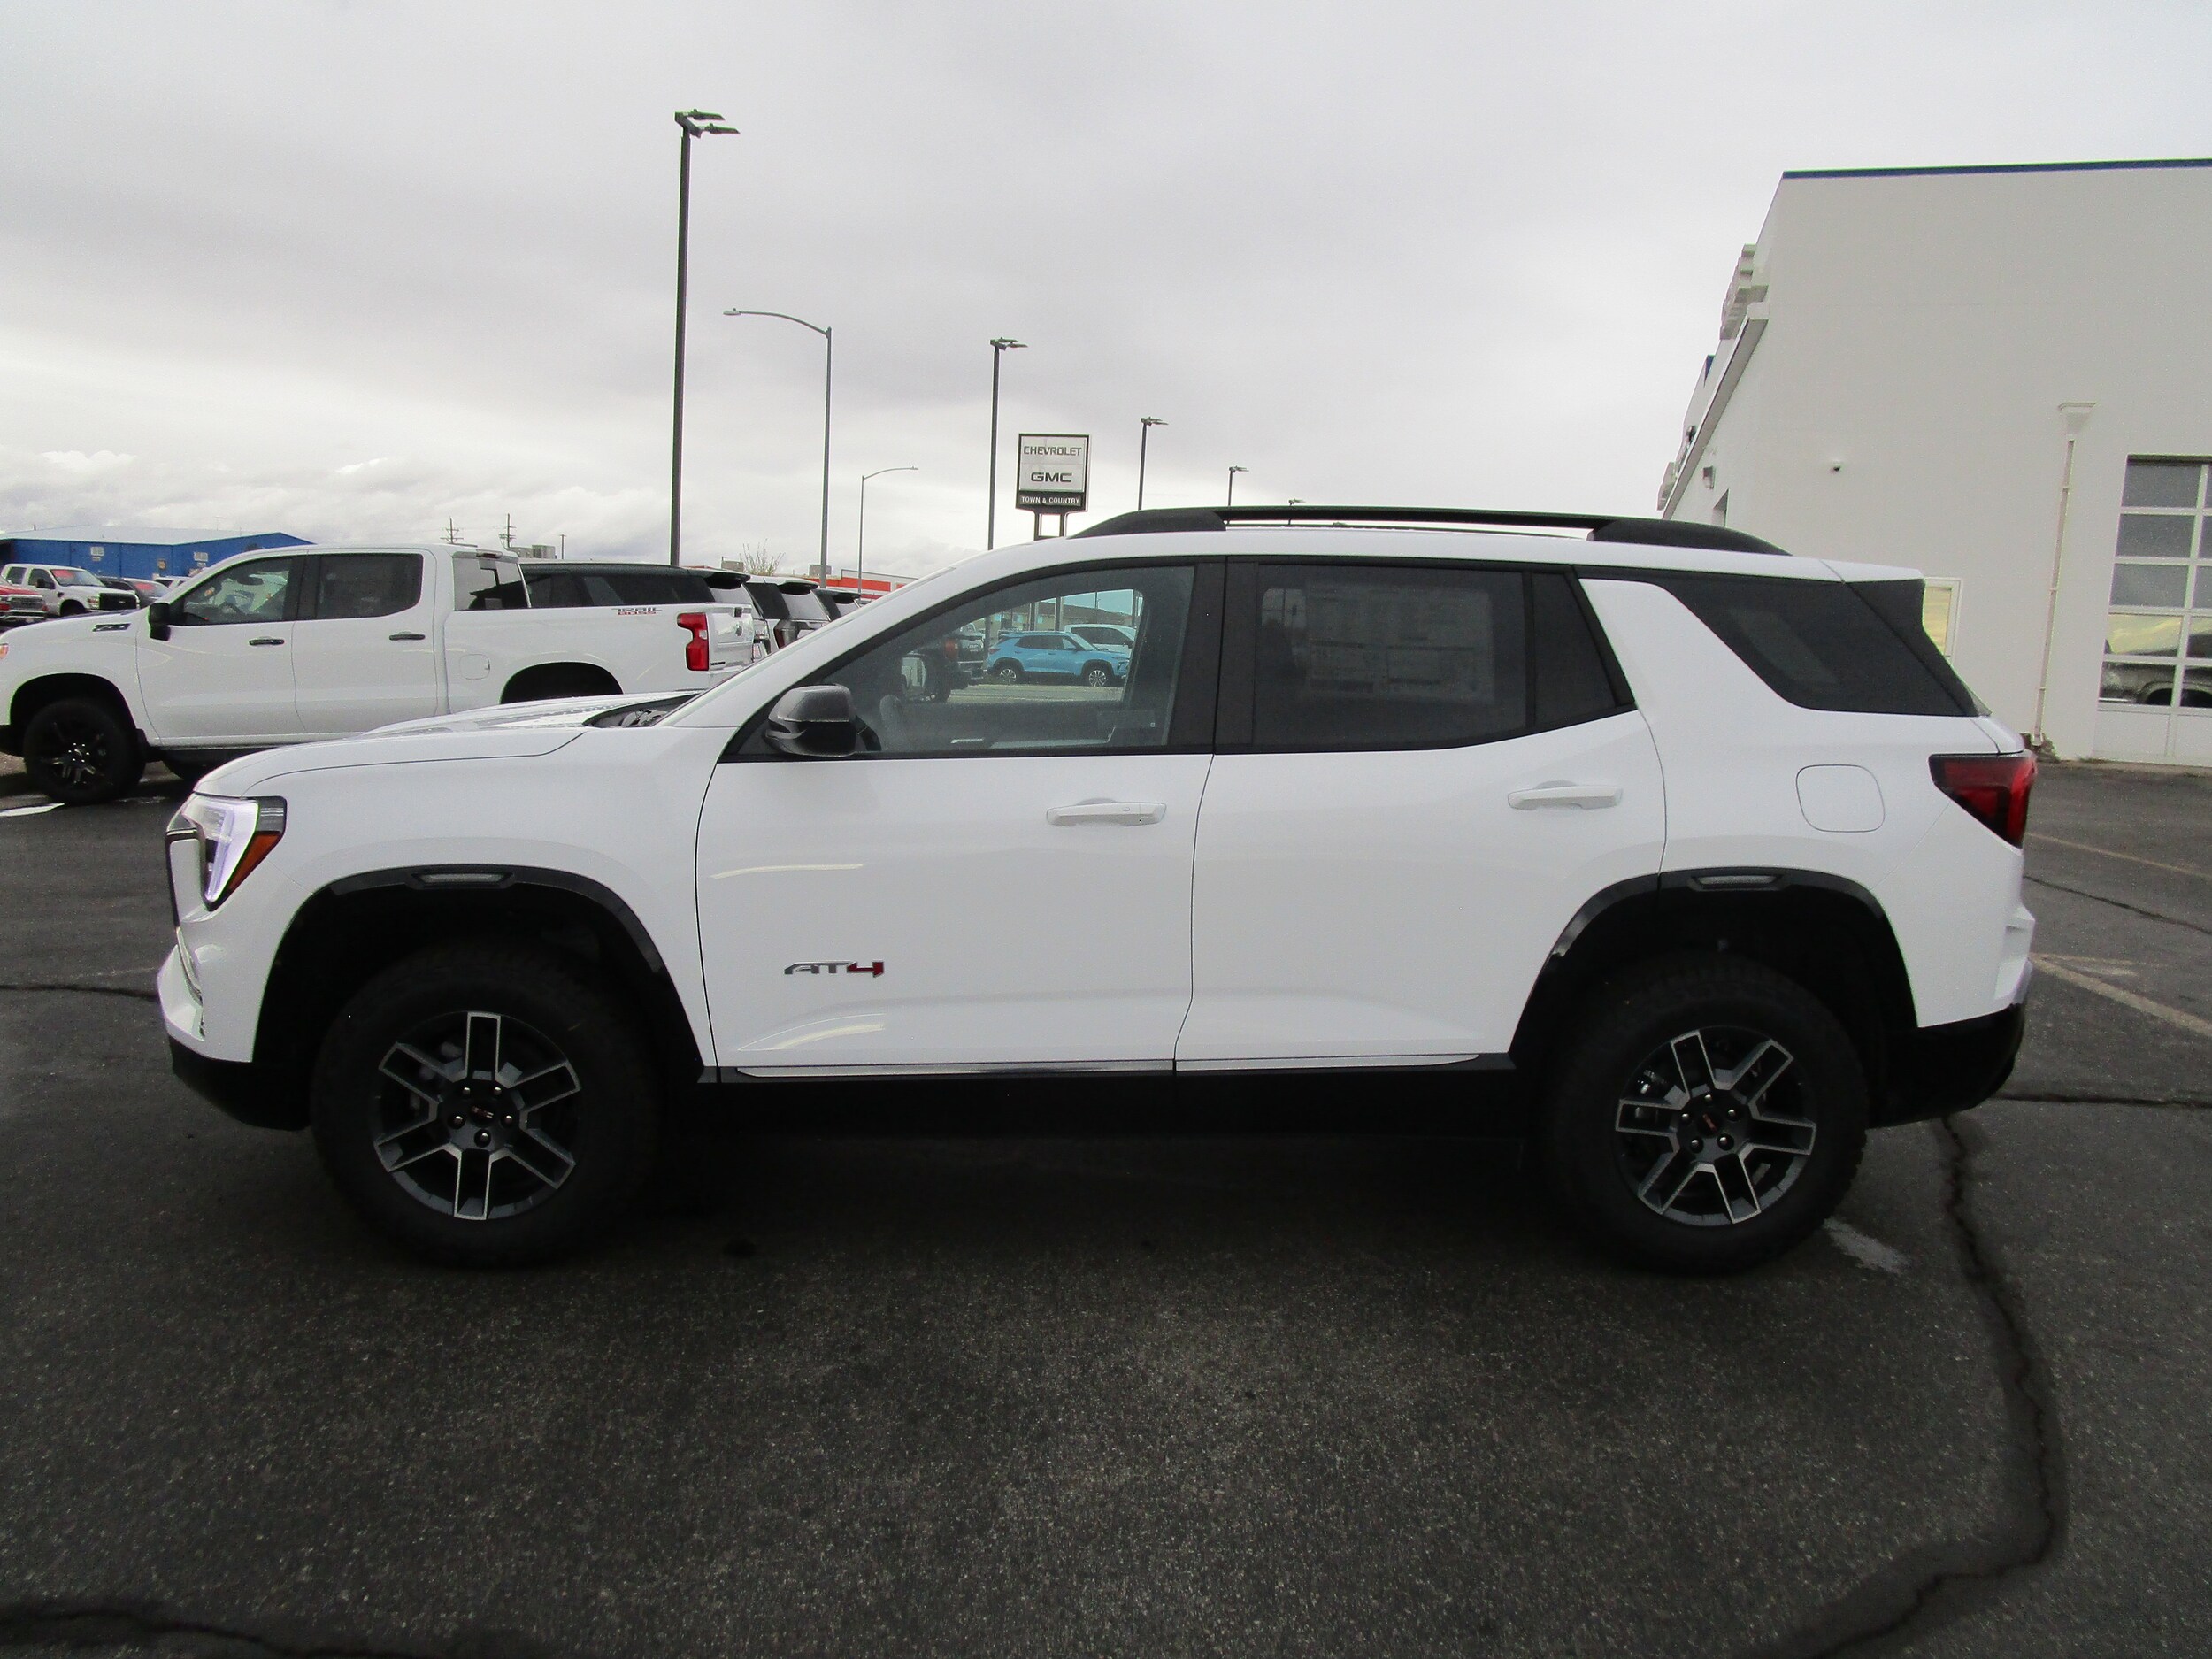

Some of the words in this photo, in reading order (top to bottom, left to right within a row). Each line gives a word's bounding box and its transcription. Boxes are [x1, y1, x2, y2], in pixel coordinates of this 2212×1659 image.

[1023, 445, 1082, 457] CHEVROLET
[1031, 472, 1072, 483] GMC
[1048, 496, 1080, 505] COUNTRY
[784, 960, 884, 978] AT4
